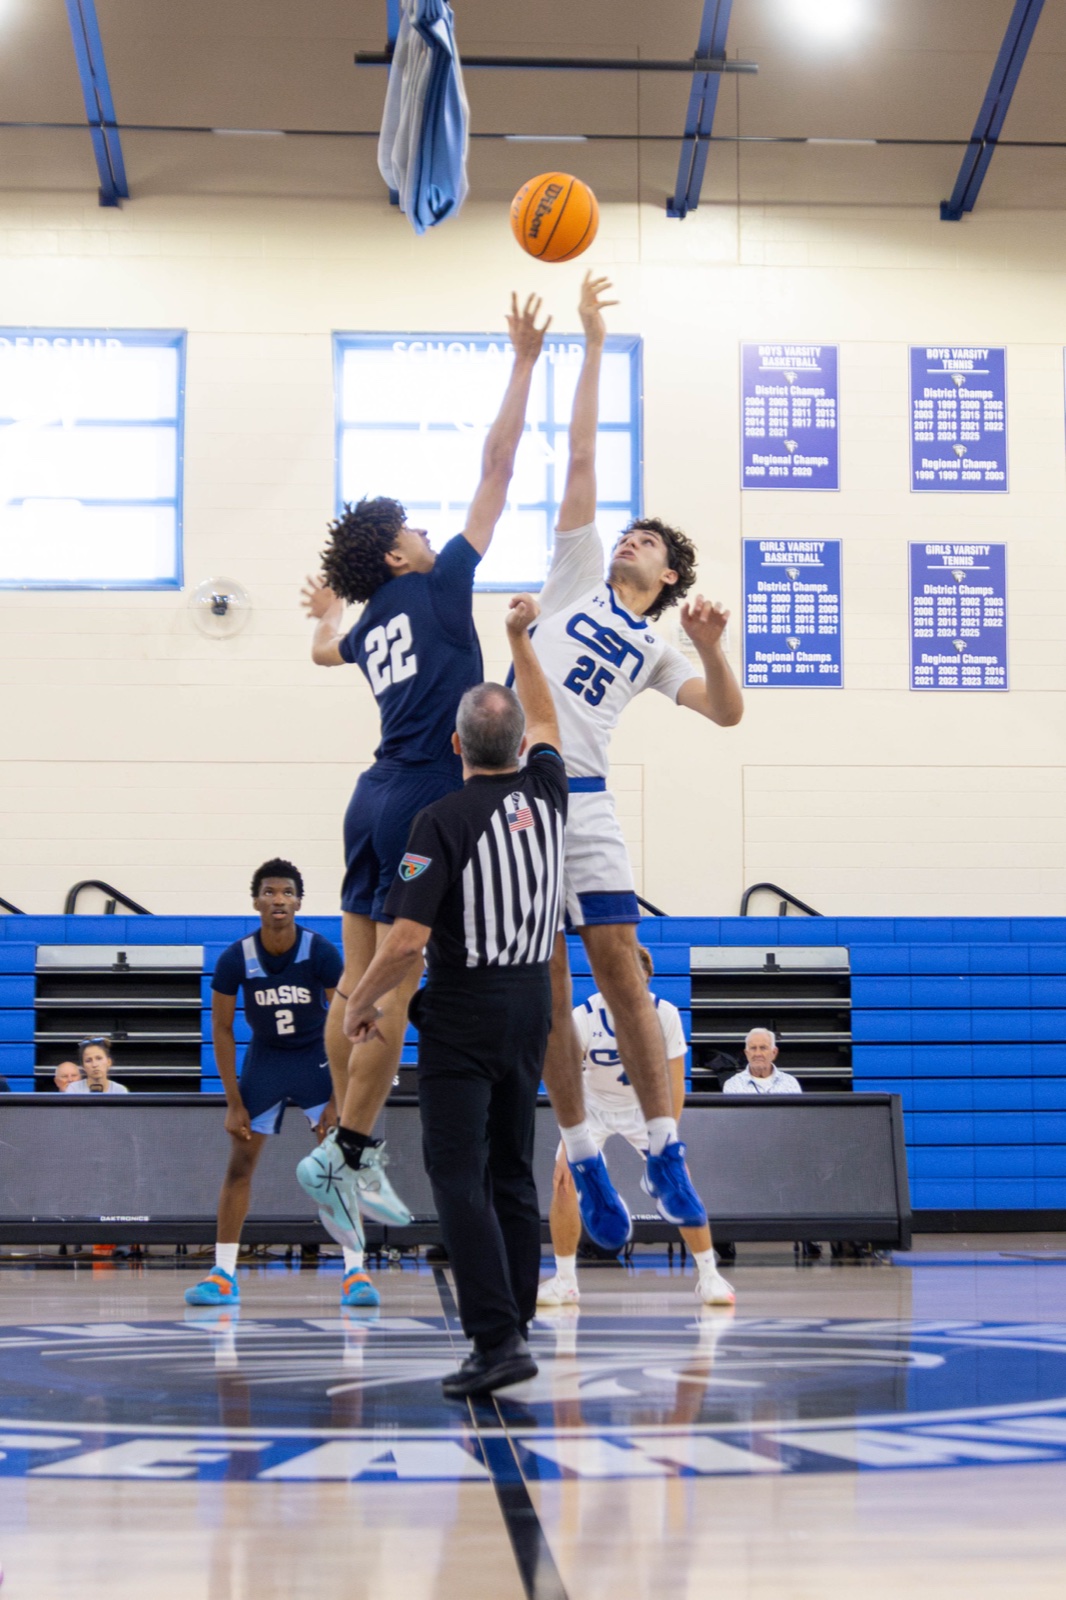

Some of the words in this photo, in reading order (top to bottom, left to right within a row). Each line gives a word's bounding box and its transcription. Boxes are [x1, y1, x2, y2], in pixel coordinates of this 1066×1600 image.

[528, 184, 563, 238] Wilson
[392, 341, 585, 363] SCHOLAHIP
[758, 346, 782, 356] BOYS
[784, 346, 821, 358] VARSITY
[926, 348, 950, 359] BOYS
[952, 349, 988, 360] VARSITY
[762, 357, 818, 367] BASKETBALL
[943, 360, 973, 369] TENNIS
[755, 385, 788, 395] District
[790, 386, 825, 398] Champs
[924, 388, 957, 398] District
[958, 389, 993, 400] Champs
[792, 408, 811, 417] 2011
[937, 410, 957, 419] 2014
[792, 418, 811, 427] 2017
[914, 421, 933, 430] 2017
[961, 422, 979, 430] 2021
[984, 422, 1004, 431] 2022
[937, 432, 957, 441] 2024
[752, 454, 791, 466] Regional
[794, 455, 828, 467] Champs
[922, 458, 960, 470] Regional
[963, 459, 997, 470] Champs
[760, 541, 785, 551] GIRLS
[787, 542, 824, 552] VARSITY
[926, 545, 951, 555] GIRLS
[953, 545, 990, 555] VARSITY
[765, 553, 820, 562] BASKETBALL
[943, 556, 974, 566] TENNIS
[757, 581, 790, 592] District
[793, 582, 828, 594] Champs
[924, 585, 957, 595] District
[958, 585, 994, 597] Champs
[771, 594, 790, 603] 2000
[795, 594, 814, 603] 2003
[818, 595, 838, 603] 2005
[914, 597, 933, 606] 2000
[937, 597, 956, 606] 2001
[960, 597, 980, 606] 2002
[984, 598, 1003, 606] 2003
[771, 604, 790, 613] 2007
[937, 607, 957, 616] 2012
[961, 608, 980, 616] 2013
[984, 608, 1004, 616] 2015
[747, 614, 767, 623] 2010
[771, 615, 790, 623] 2011
[795, 615, 814, 623] 2012
[818, 615, 838, 624] 2013
[914, 617, 933, 626] 2016
[961, 618, 980, 626] 2021
[983, 618, 1003, 627] 2022
[748, 625, 768, 633] 2014
[771, 625, 791, 633] 2015
[795, 625, 814, 634] 2016
[818, 625, 837, 634] 2021
[914, 629, 934, 637] 2023
[937, 628, 956, 637] 2024
[960, 628, 980, 637] 2025
[364, 612, 418, 696] 22
[755, 652, 794, 663] Regional
[797, 652, 831, 663] Champs
[921, 654, 960, 665] Regional
[962, 654, 998, 665] Champs
[772, 664, 791, 673] 2010
[795, 664, 814, 673] 2011
[819, 665, 839, 673] 2012
[914, 666, 933, 675] 2001
[938, 666, 958, 675] 2002
[962, 667, 981, 675] 2003
[985, 667, 1005, 675] 2016
[562, 655, 616, 707] 25
[748, 674, 768, 683] 2016
[915, 677, 933, 685] 2021
[938, 677, 958, 685] 2022
[962, 677, 981, 685] 2023
[984, 677, 1004, 685] 2024
[254, 985, 311, 1006] OASIS
[274, 1009, 296, 1035] 2
